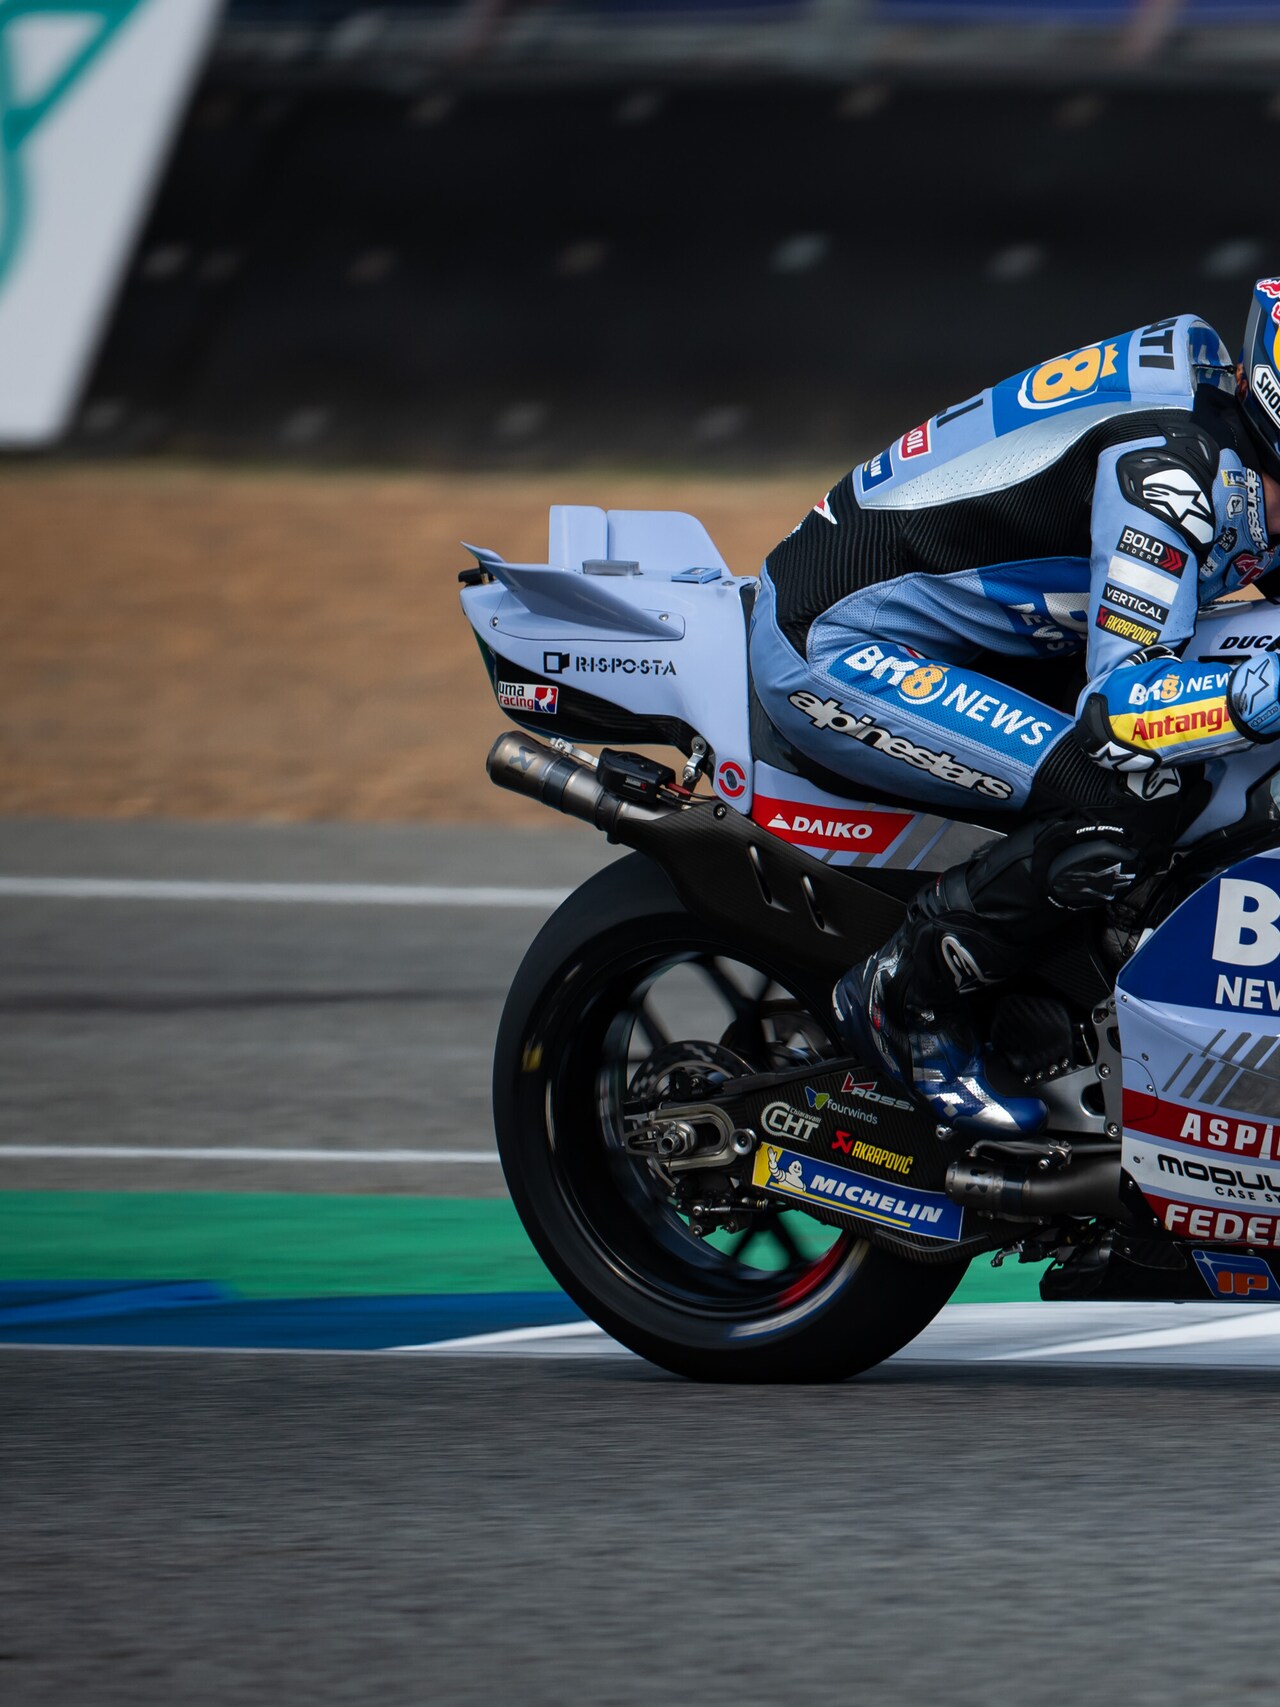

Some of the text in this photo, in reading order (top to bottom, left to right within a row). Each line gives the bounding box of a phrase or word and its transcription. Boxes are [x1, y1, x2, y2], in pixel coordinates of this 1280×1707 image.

[1119, 543, 1159, 563] RIDERS
[1122, 529, 1164, 556] BOLD
[1106, 586, 1162, 620] VERTICAL
[499, 682, 525, 696] uma
[499, 695, 535, 710] racing
[843, 645, 1053, 746] BK8 NEWS
[1128, 674, 1232, 706] BK8 NEW
[1131, 701, 1230, 741] Antangi
[787, 690, 1015, 801] alpinestars
[791, 816, 873, 839] DAIKO
[1076, 826, 1095, 835] one
[768, 1108, 820, 1140] CHT
[827, 1098, 878, 1125] fourwinds
[810, 1174, 944, 1223] MICHELIN
[1214, 1186, 1256, 1201] CASE
